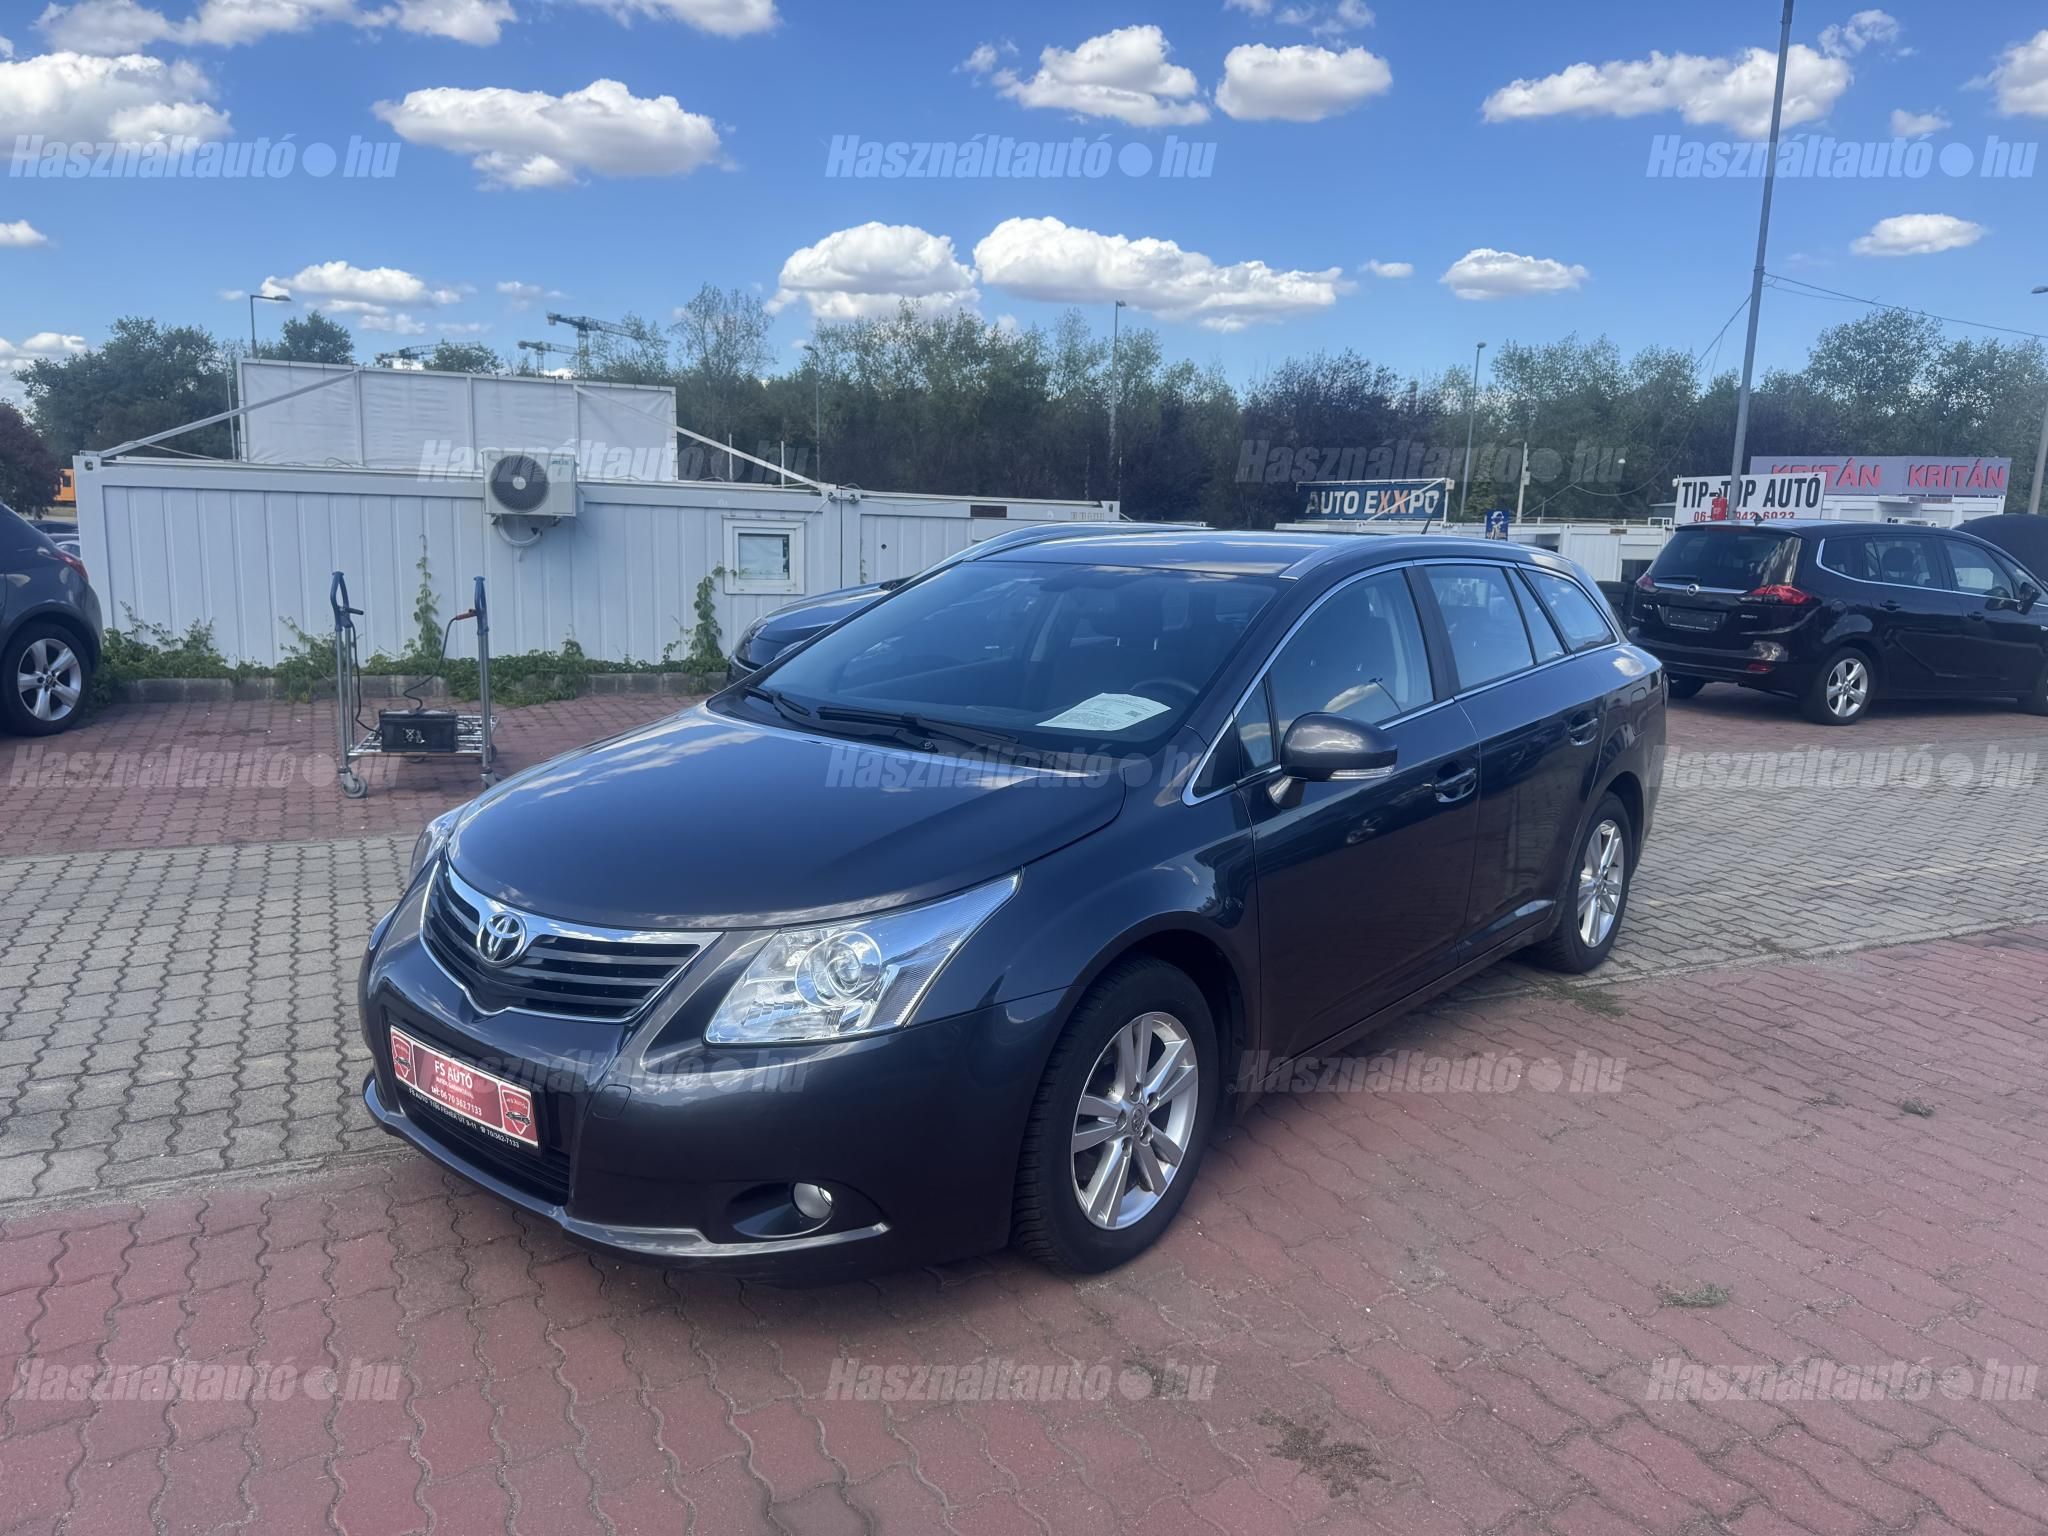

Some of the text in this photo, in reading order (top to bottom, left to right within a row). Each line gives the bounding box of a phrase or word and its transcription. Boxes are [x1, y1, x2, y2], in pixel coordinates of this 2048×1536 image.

[1907, 458, 2004, 489] KRITÁN
[1305, 489, 1440, 515] AUTO EXXPO
[1762, 474, 1821, 509] AUTÓ
[434, 1060, 446, 1077] FS
[447, 1066, 473, 1089] AUTÓ
